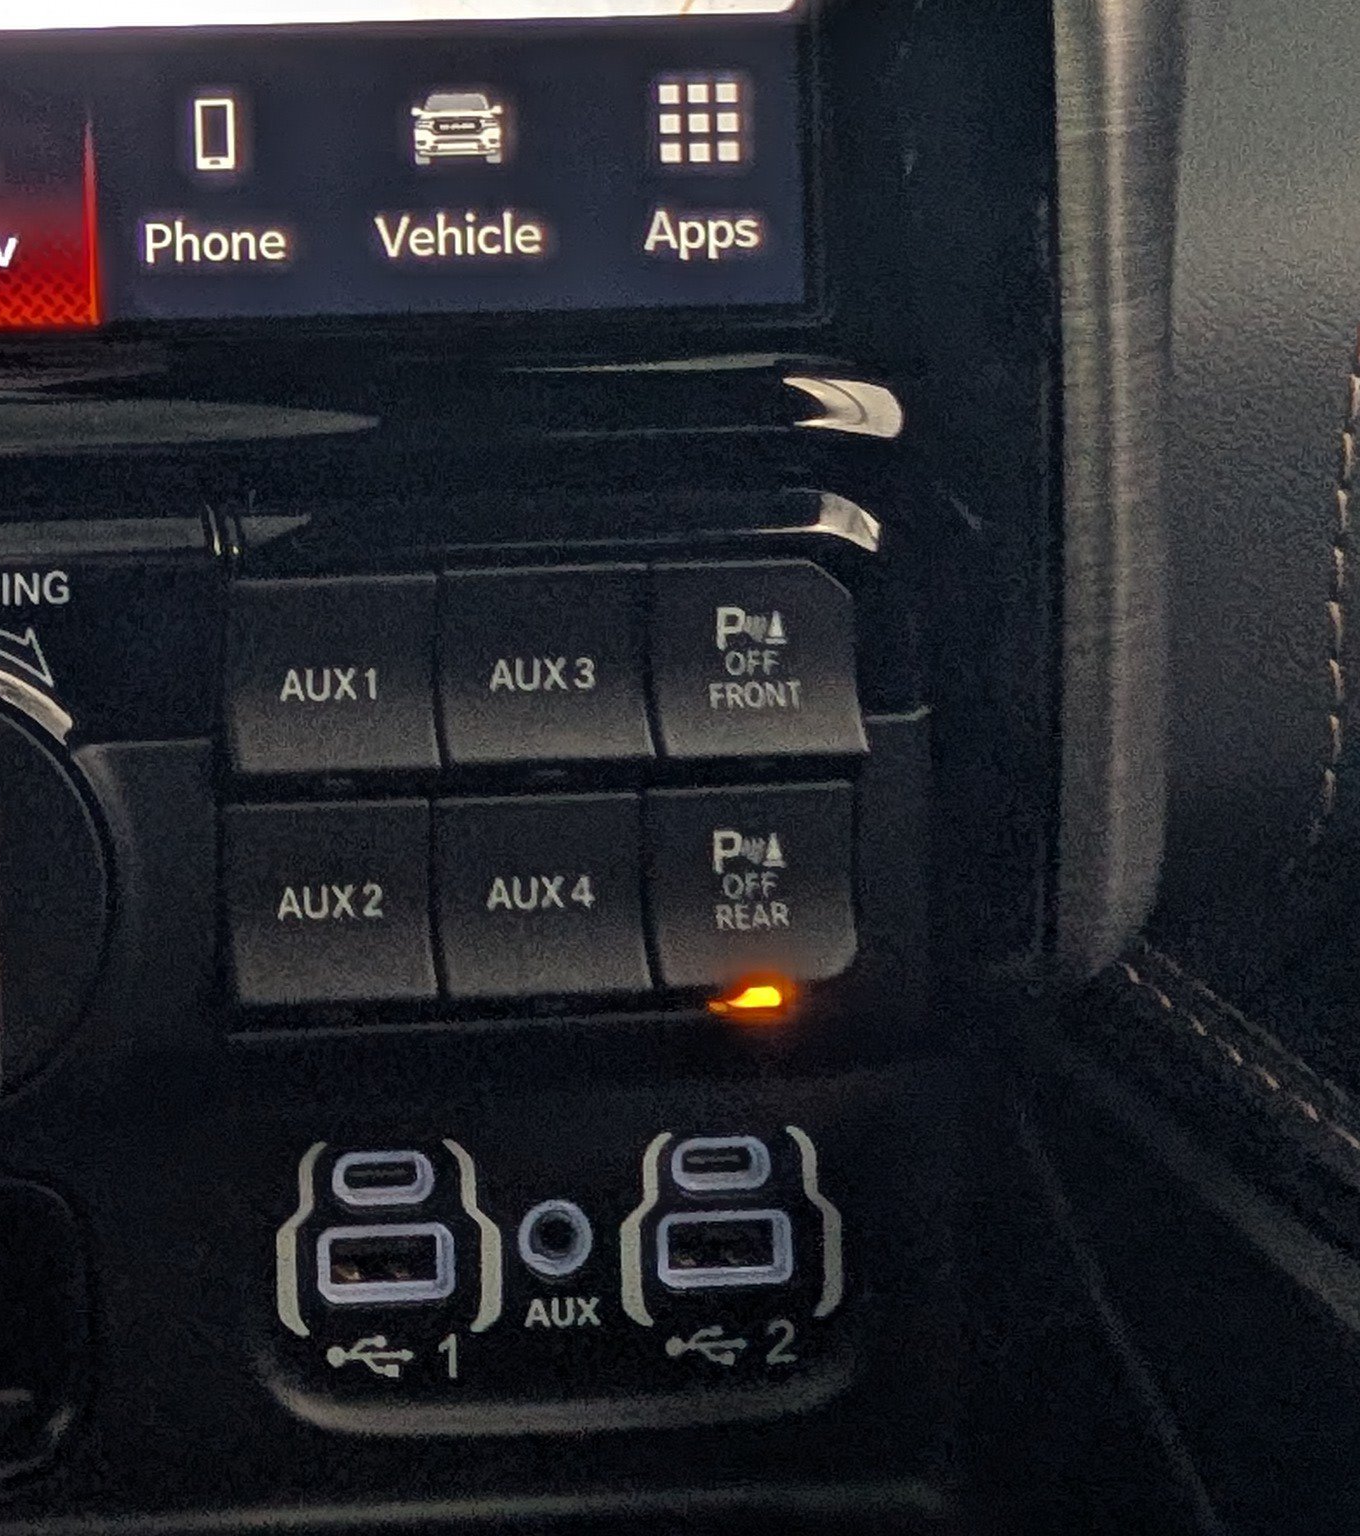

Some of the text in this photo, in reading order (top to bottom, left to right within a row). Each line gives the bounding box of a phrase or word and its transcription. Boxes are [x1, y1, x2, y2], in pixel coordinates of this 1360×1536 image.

[144, 221, 287, 263] Phone
[374, 209, 543, 258] Vehicle
[643, 209, 760, 260] Apps
[724, 649, 780, 676] OFF
[708, 679, 802, 710] FRONT
[721, 871, 779, 900] OFF
[715, 900, 791, 931] REAR
[523, 1296, 602, 1329] AUX
[437, 1332, 459, 1379] 1
[765, 1318, 798, 1365] 2
